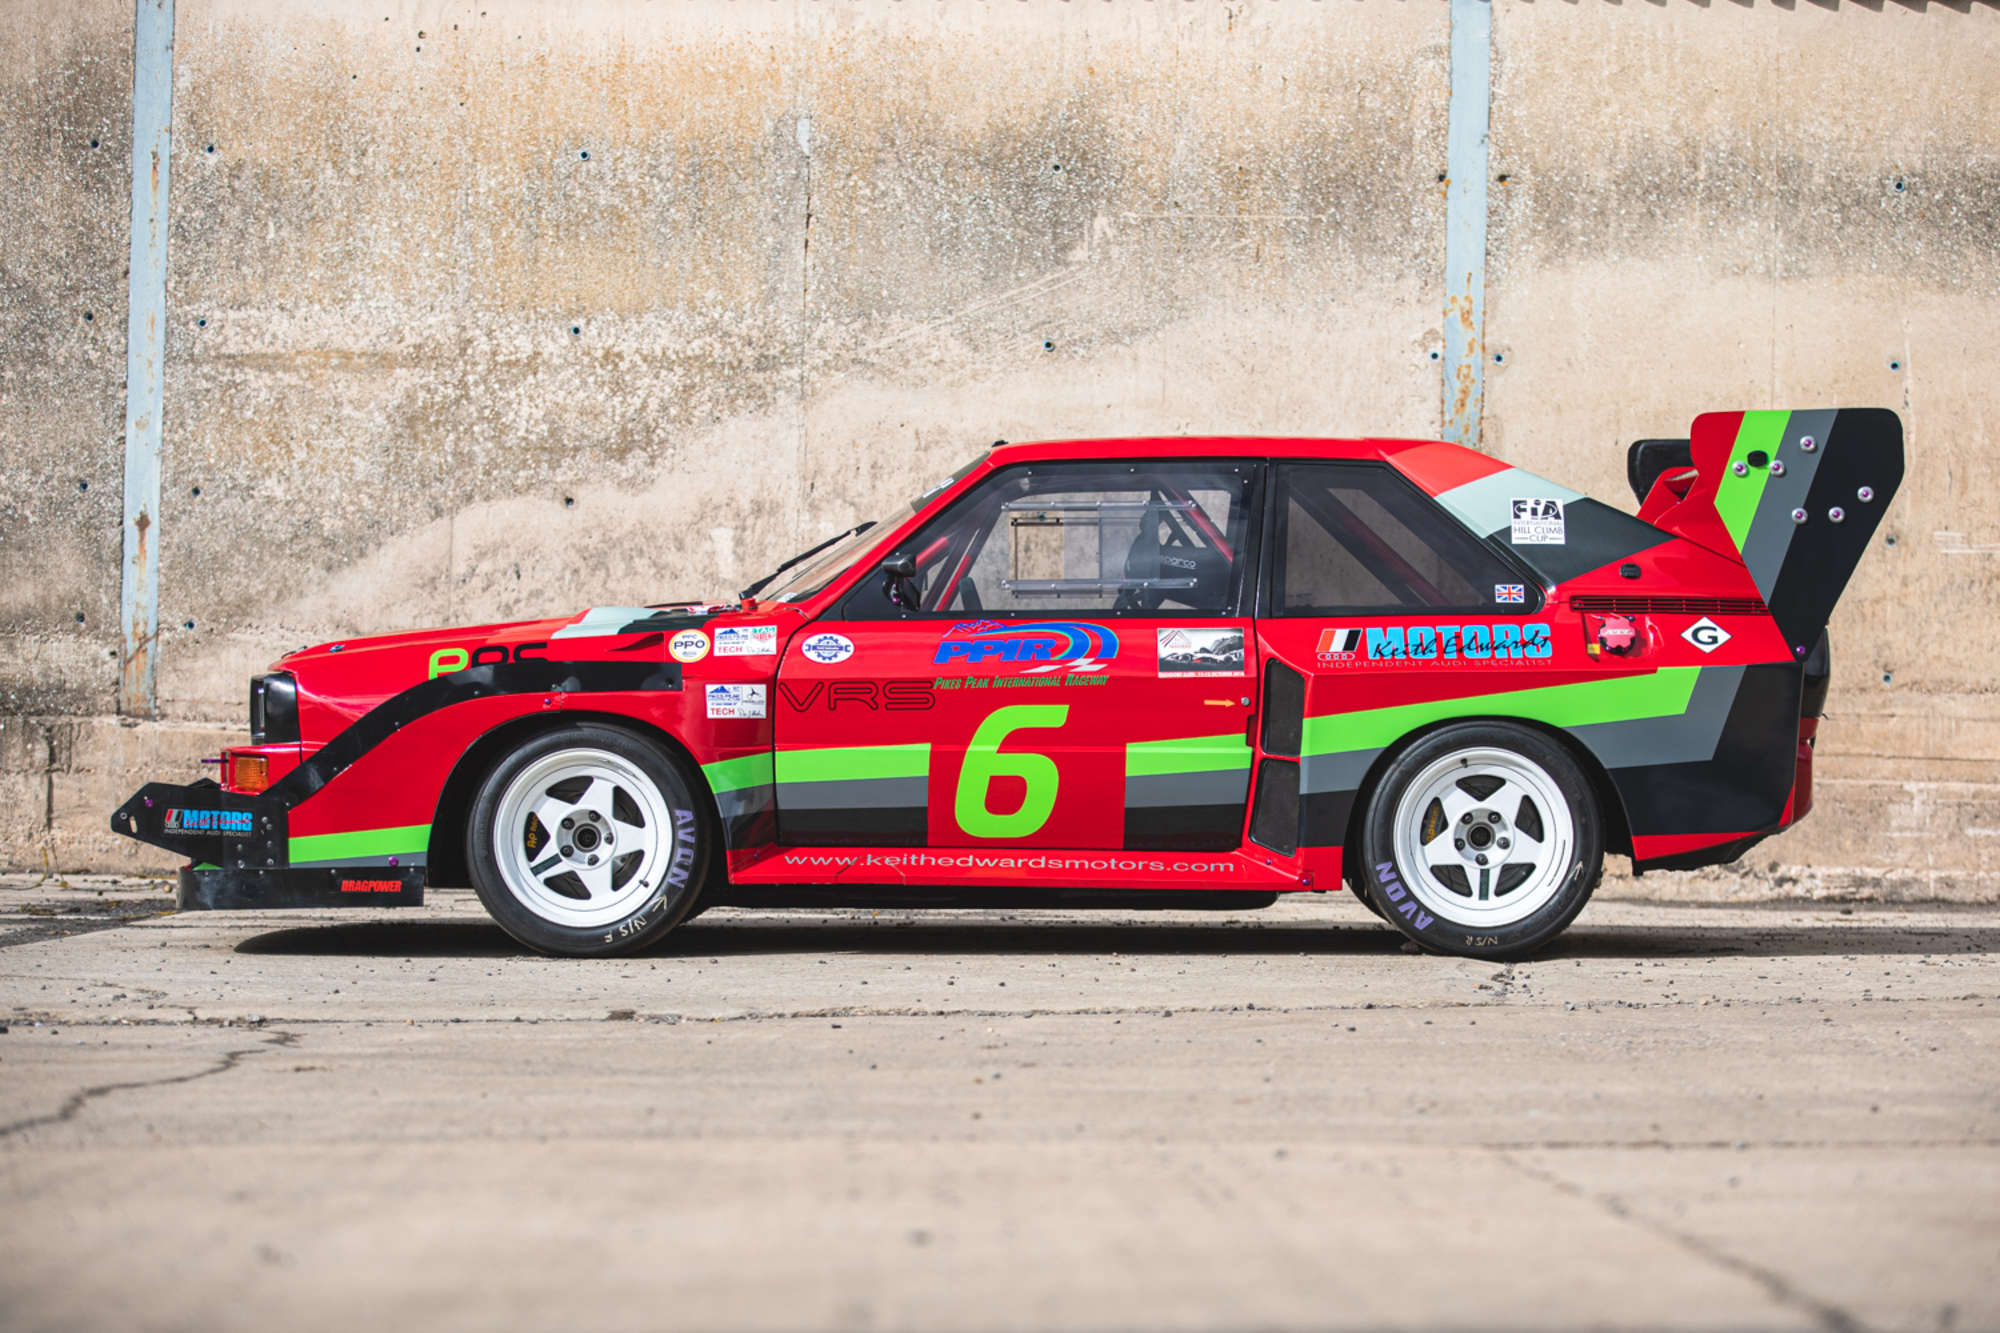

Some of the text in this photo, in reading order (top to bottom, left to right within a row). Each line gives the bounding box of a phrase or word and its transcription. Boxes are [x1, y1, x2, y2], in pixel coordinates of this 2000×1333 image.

[1534, 527, 1563, 535] CLIMB
[673, 639, 706, 650] PPO
[1366, 623, 1553, 660] MOTORS
[1373, 630, 1549, 658] Keith Edwards
[1691, 625, 1719, 646] G
[717, 646, 743, 654] TECH
[934, 638, 1057, 663] PPIR
[1317, 658, 1553, 669] INDEPENDENT AUDI SPECIALIST
[933, 673, 1110, 690] PIKES PEAK INTERNATIONAL RACEWAY
[779, 680, 936, 712] VRS
[711, 707, 736, 716] TECH
[954, 704, 1070, 838] 6
[183, 808, 253, 832] MOTORS
[668, 809, 696, 889] AVON
[784, 853, 1235, 873] www.keithedwardsmotors.com
[341, 880, 402, 892] DRAGPOWER
[1375, 861, 1434, 930] AVON
